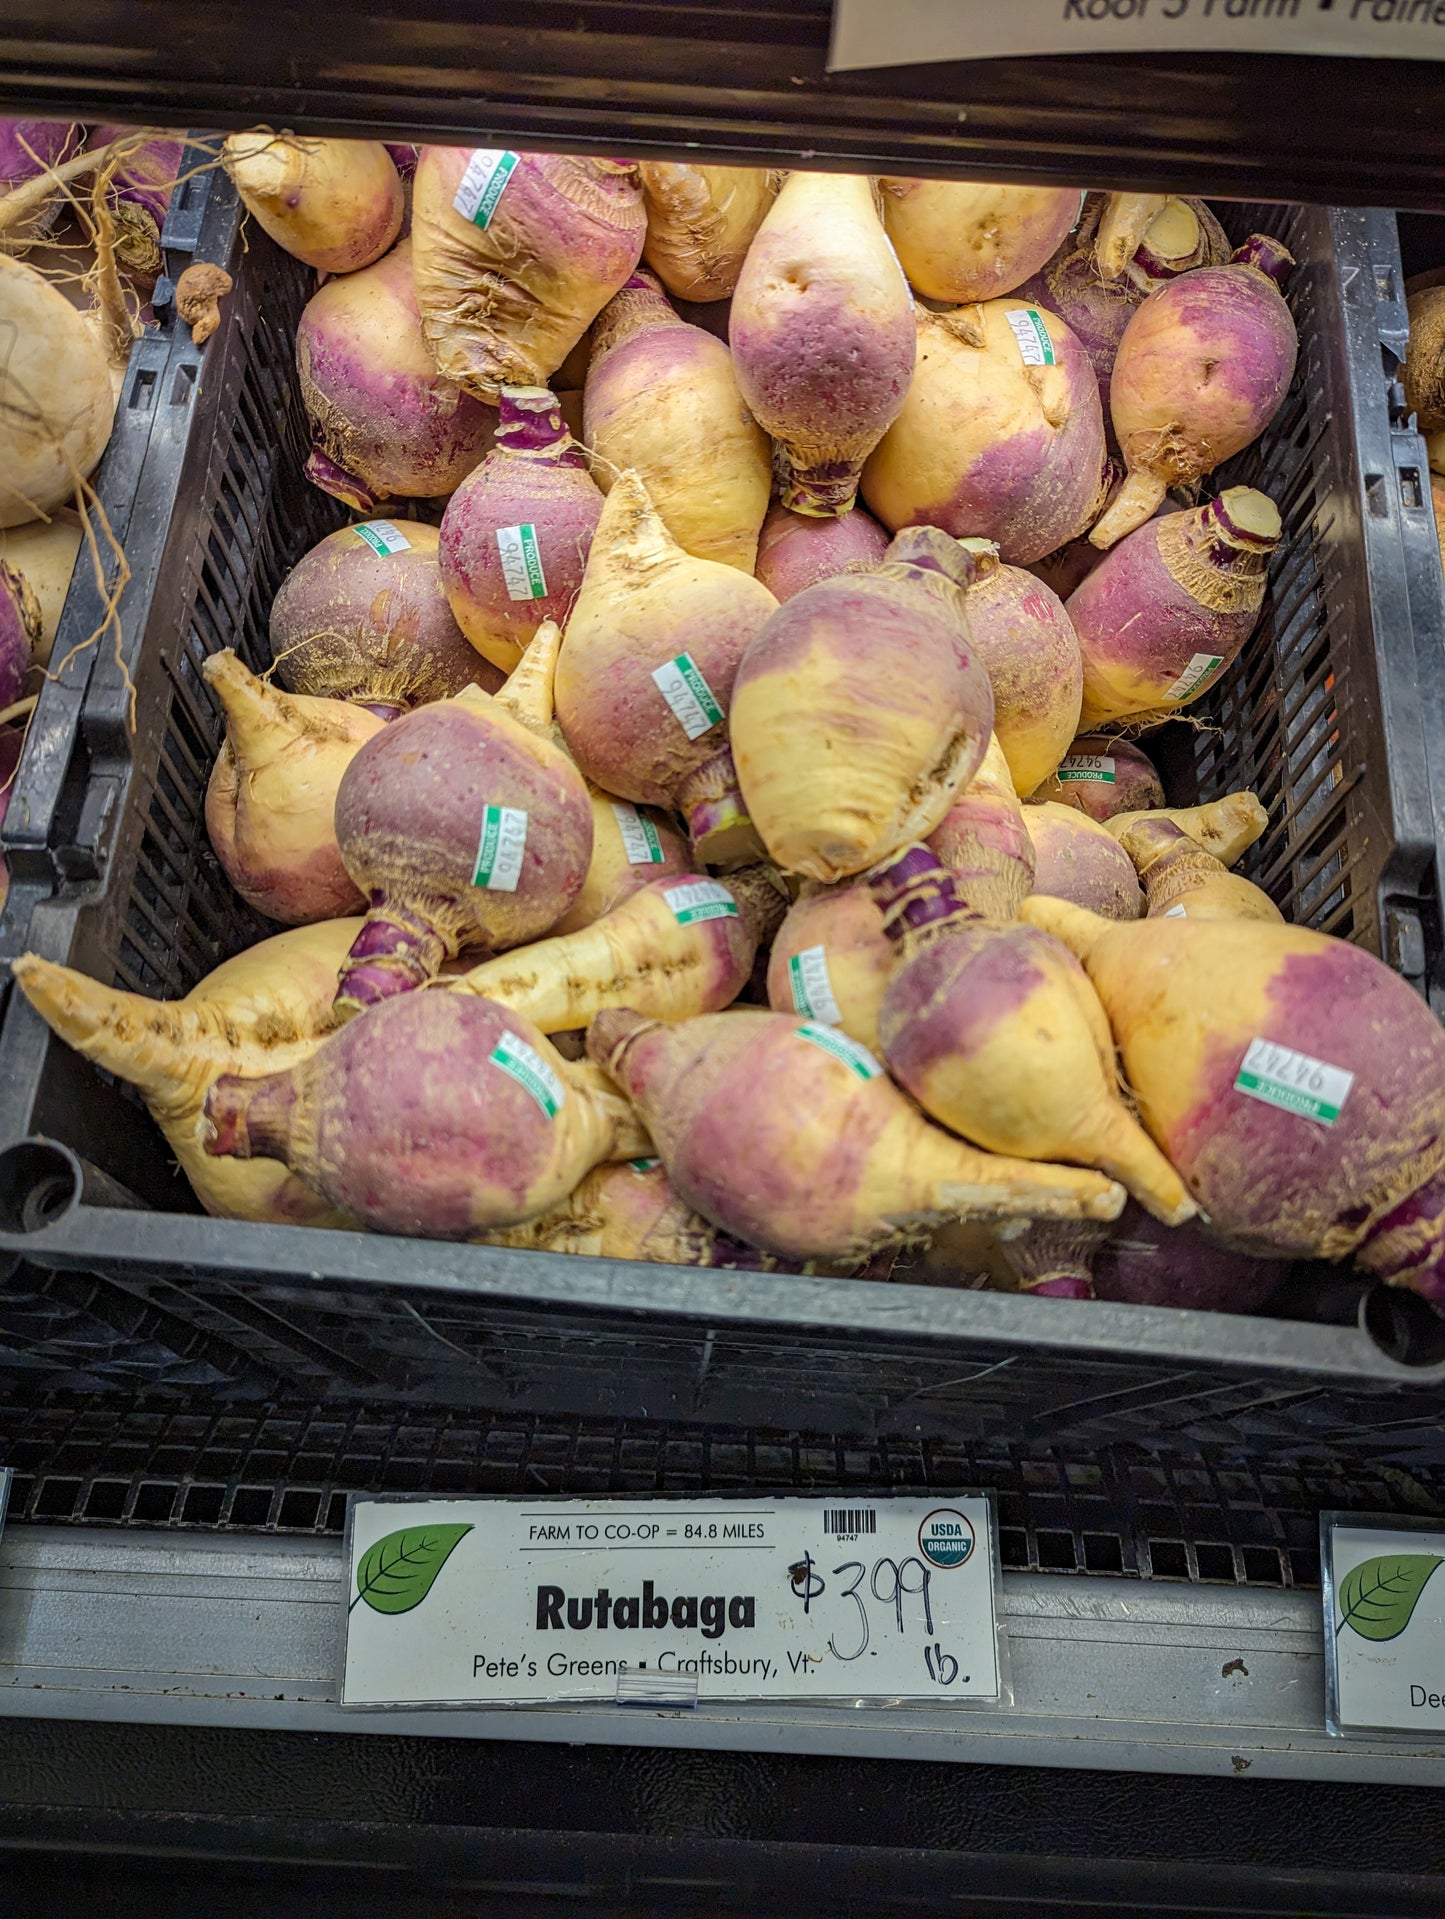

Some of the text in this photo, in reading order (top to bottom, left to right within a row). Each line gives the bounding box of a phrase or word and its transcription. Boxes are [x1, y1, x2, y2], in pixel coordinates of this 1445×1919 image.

[480, 167, 508, 217] PRODUCE
[1012, 321, 1040, 362] 94747
[1033, 317, 1051, 353] PRODUCE
[360, 528, 382, 547] PRODUCE
[502, 543, 528, 595] 94747
[523, 539, 540, 585] PRODUCE
[685, 670, 716, 713] PRODUCE
[1167, 665, 1203, 698] 94747
[663, 680, 709, 732] 94747
[1061, 755, 1102, 768] 94747
[1066, 771, 1102, 779] PRODUCE
[480, 823, 498, 873] PRODUCE
[498, 812, 523, 874] 94747
[618, 815, 648, 861] 94747
[690, 903, 729, 919] PRODUCE
[802, 954, 826, 1011] 94747
[507, 1059, 550, 1102] PRODUCE
[1247, 1043, 1324, 1090] 94747
[1256, 1080, 1321, 1111] PRODUCE
[529, 1525, 570, 1540] FARM
[576, 1525, 599, 1540] TO
[604, 1524, 660, 1539] CO-OP
[684, 1524, 718, 1539] 84.8
[723, 1524, 765, 1538] MILES
[928, 1541, 967, 1552] ORGANIC
[931, 1523, 962, 1536] USDA
[536, 1580, 756, 1639] Rutabaga
[473, 1650, 815, 1680] Pete's Greens Craftsbury, Vt.
[924, 1643, 971, 1685] lb.
